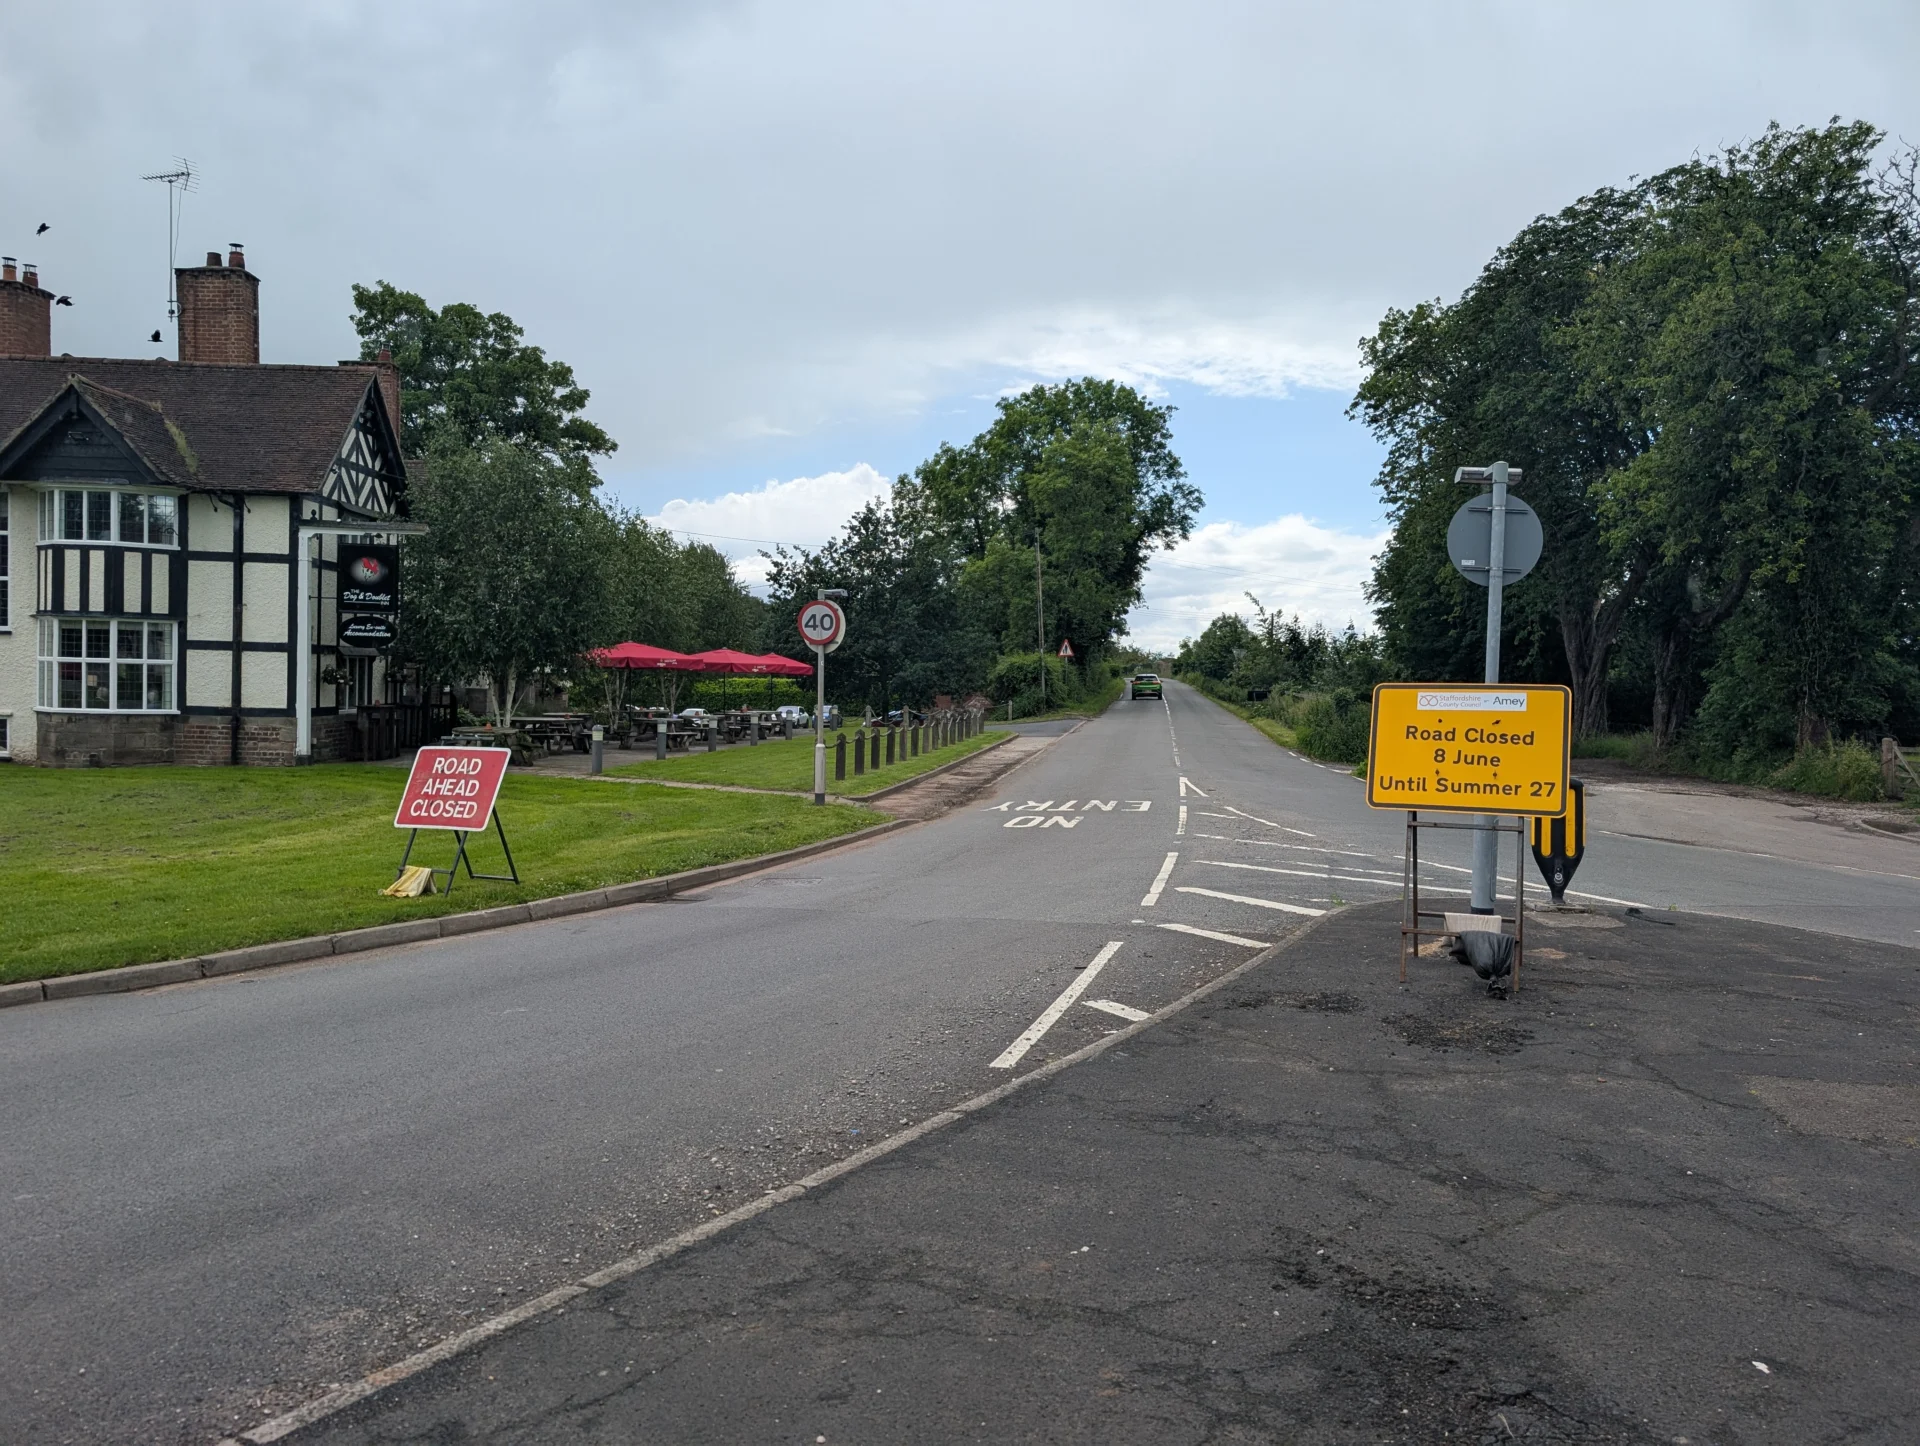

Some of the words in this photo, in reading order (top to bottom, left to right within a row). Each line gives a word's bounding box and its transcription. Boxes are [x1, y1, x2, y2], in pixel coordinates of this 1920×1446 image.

[343, 591, 358, 601] Dog
[359, 592, 364, 600] &
[365, 592, 391, 600] Doublet
[804, 613, 834, 631] 40
[343, 629, 391, 637] Accommodation
[1492, 696, 1526, 708] Amey
[1405, 725, 1456, 742] Road
[1464, 728, 1535, 746] Closed
[432, 757, 482, 775] ROAD
[1433, 748, 1446, 763] 8
[1453, 750, 1501, 767] June
[421, 778, 480, 796] AHEAD
[1379, 776, 1427, 792] Until
[1435, 778, 1522, 796] Summer
[1530, 781, 1556, 798] 27
[410, 799, 478, 818] CLOSED
[980, 800, 1152, 812] ENTRY
[1003, 815, 1084, 828] NO
